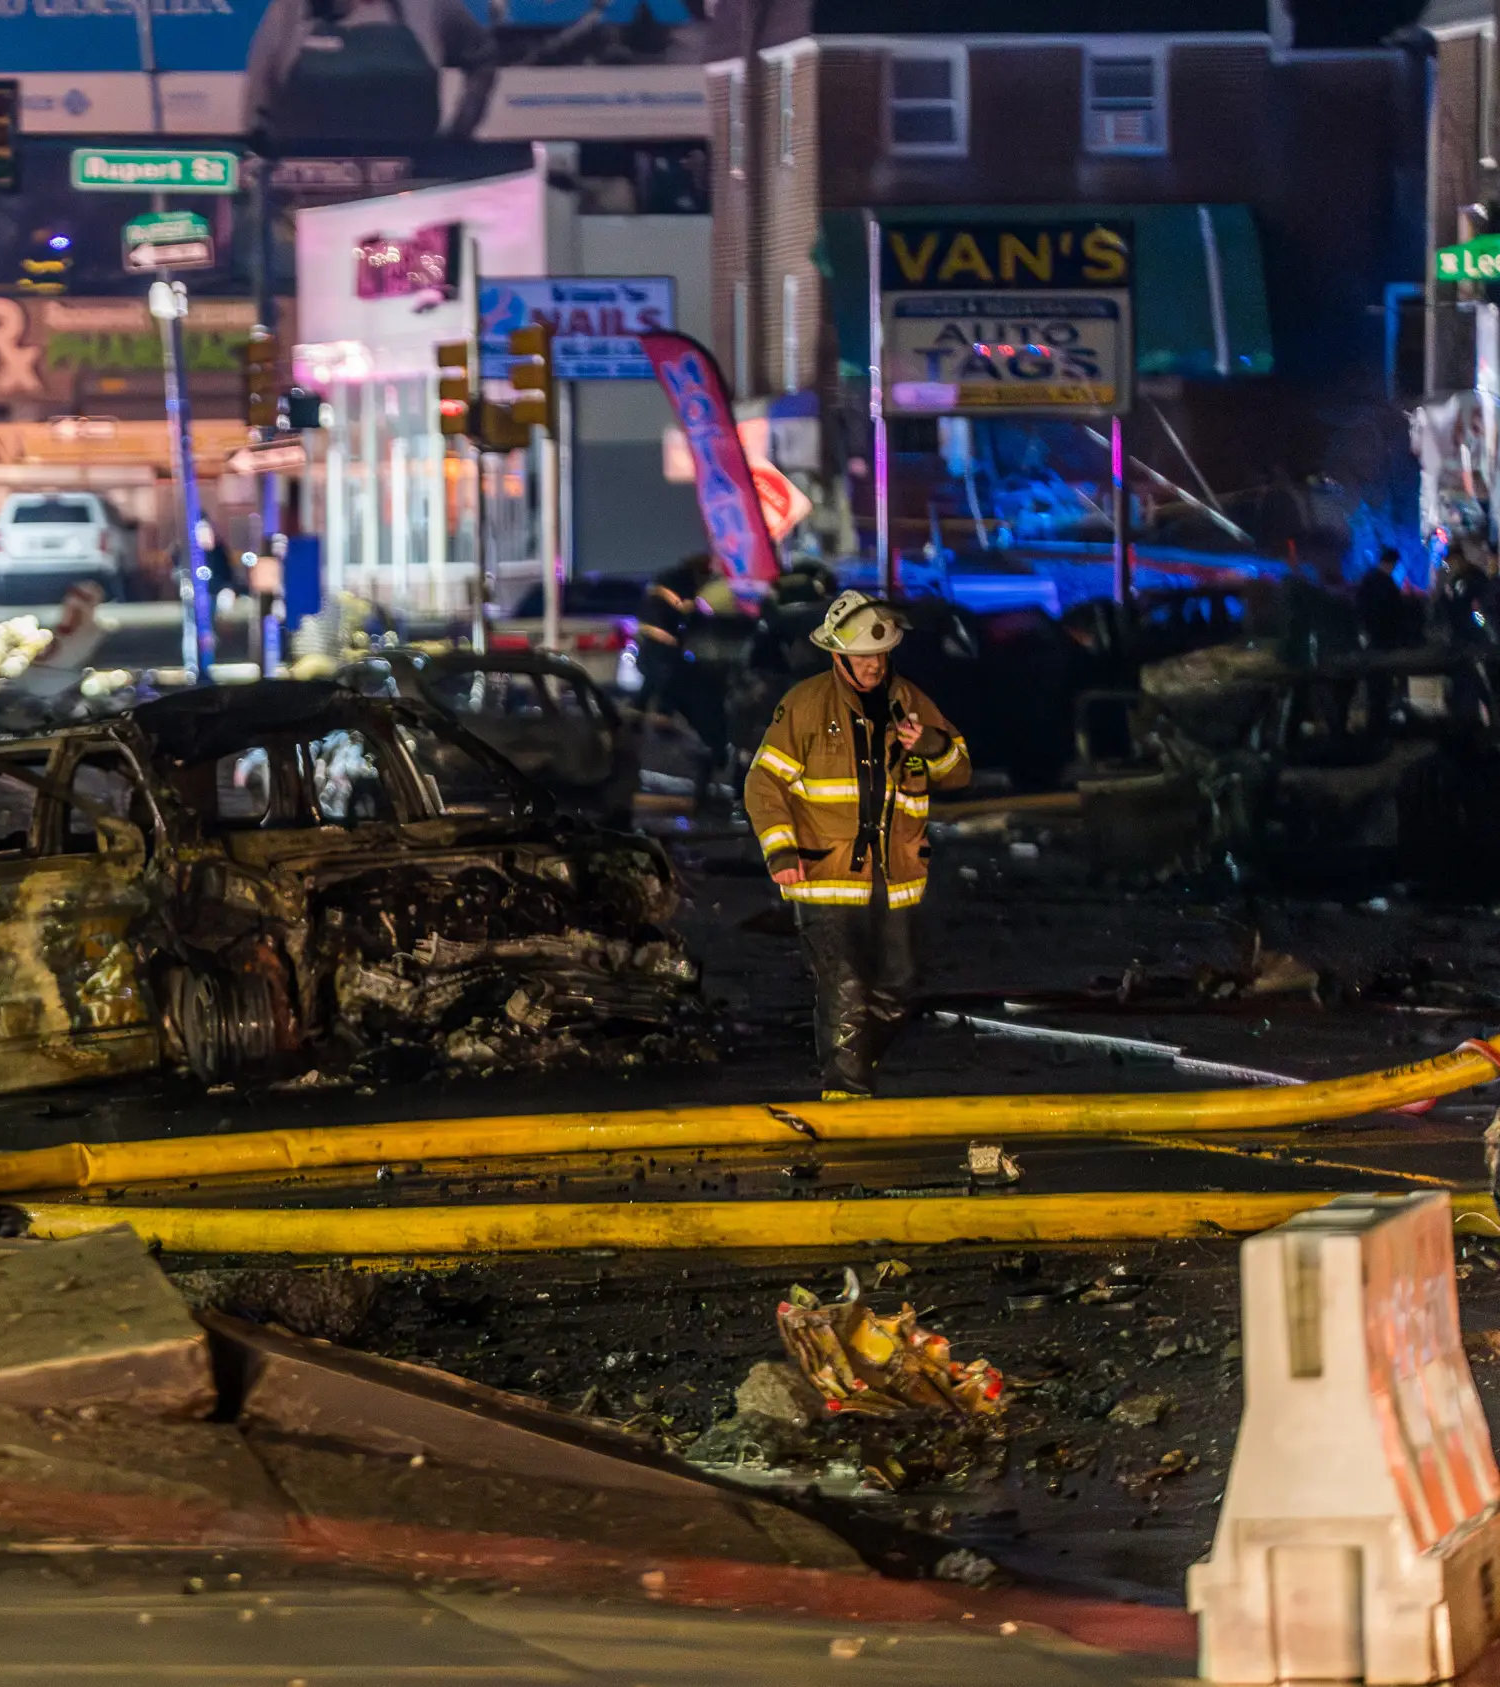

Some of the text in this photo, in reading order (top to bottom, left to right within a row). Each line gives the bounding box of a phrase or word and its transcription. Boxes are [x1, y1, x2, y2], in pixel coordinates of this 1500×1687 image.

[84, 156, 226, 183] Rupert St
[889, 224, 1129, 282] VAN'S
[932, 323, 1080, 347] AUTO
[913, 346, 1102, 382] TAGS
